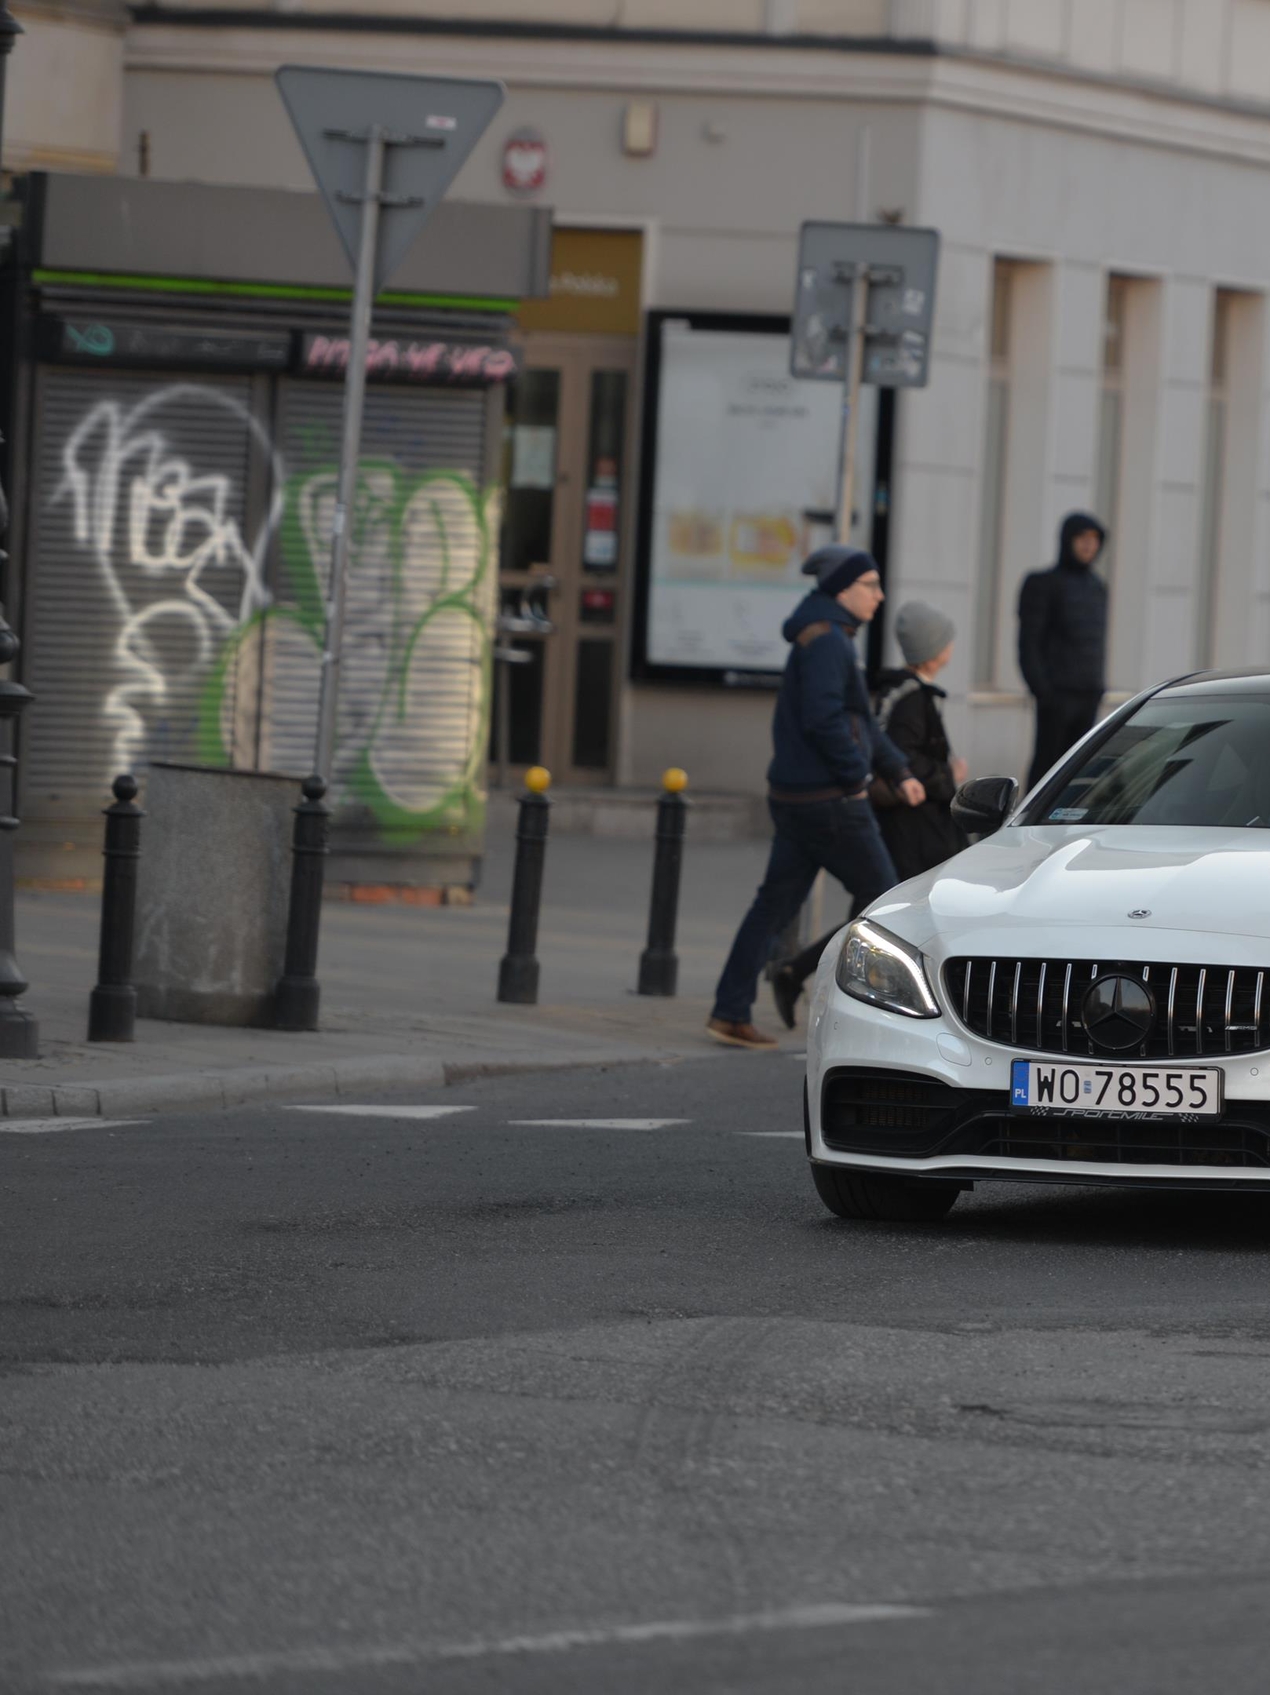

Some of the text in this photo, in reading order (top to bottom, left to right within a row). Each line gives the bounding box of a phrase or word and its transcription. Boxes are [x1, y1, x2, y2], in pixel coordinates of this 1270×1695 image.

[1014, 1088, 1027, 1099] PL
[1037, 1067, 1207, 1108] WO 78555
